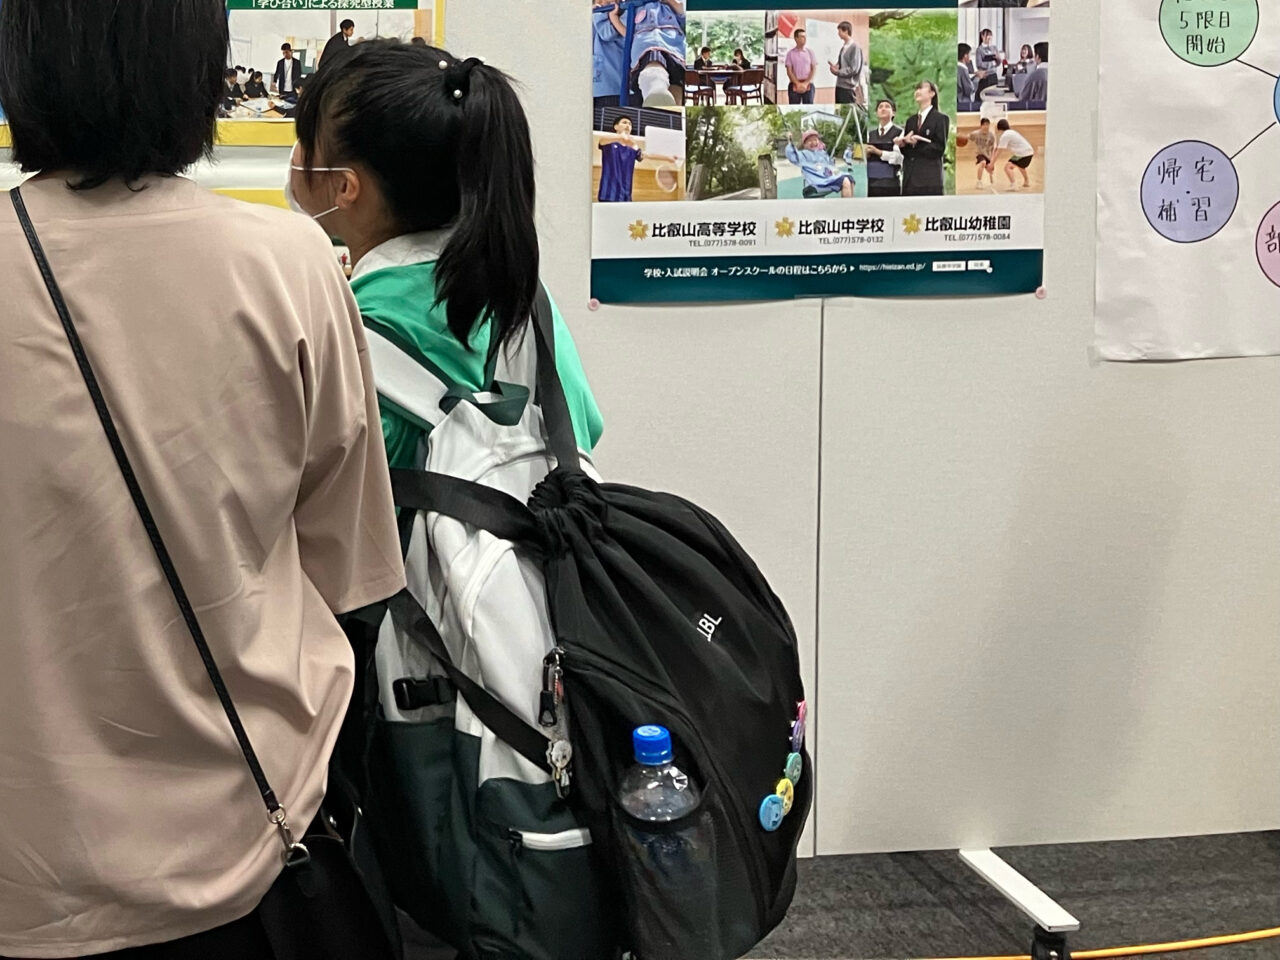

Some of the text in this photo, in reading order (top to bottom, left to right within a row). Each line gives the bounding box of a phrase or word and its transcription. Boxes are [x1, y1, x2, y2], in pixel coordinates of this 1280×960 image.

[1186, 34, 1226, 55] 開始
[1157, 157, 1216, 186] 帰宅
[651, 221, 757, 238] 比叡山高等学校
[798, 218, 884, 236] 比叡山中学校
[924, 215, 1011, 233] 比叡山幼稚園
